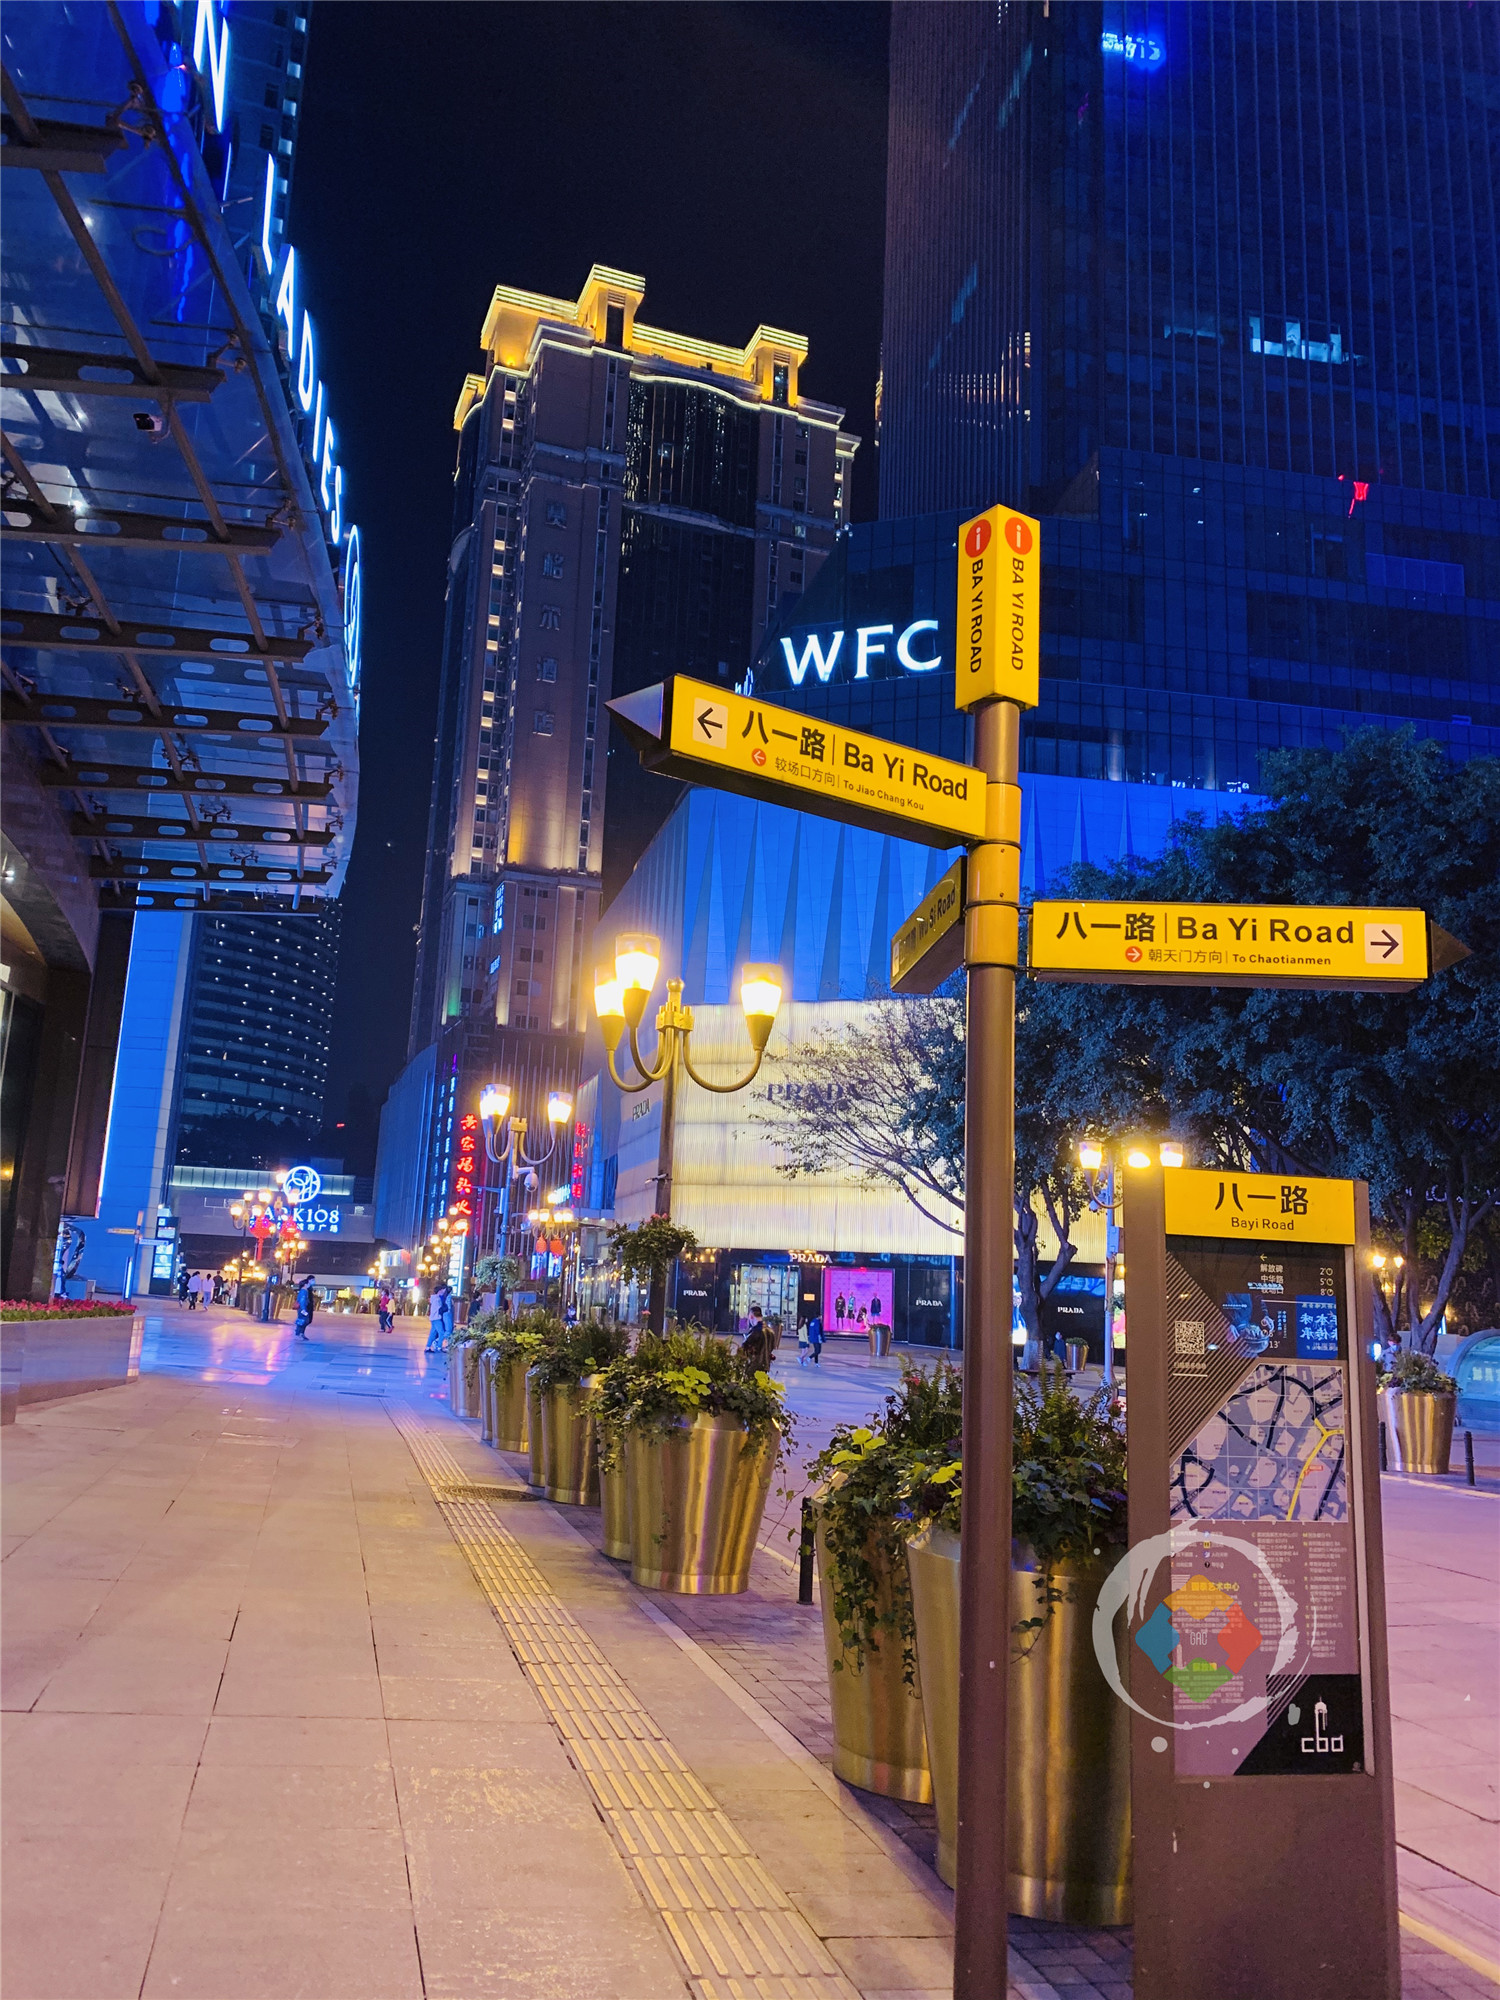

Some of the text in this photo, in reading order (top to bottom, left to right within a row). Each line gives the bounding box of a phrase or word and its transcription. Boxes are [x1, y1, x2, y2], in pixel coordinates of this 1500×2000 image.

[970, 559, 984, 674] BA YI ROAD
[1011, 557, 1025, 671] BA YI ROAD
[780, 620, 942, 685] WFC
[742, 710, 969, 802] 八一路 Ba Yi Road
[774, 756, 925, 811] 较场口方向 To Jiao Chang Kou
[937, 884, 956, 920] Road
[1056, 911, 1355, 945] 八一路 Ba Yi Road
[1147, 948, 1332, 967] 朝天门方向 To Chaotianmen
[632, 1098, 651, 1122] PRADA
[1215, 1182, 1309, 1216] 八一路
[1231, 1217, 1295, 1231] Bayi Road
[789, 1253, 833, 1264] PRADA
[683, 1289, 708, 1297] PRADA
[915, 1298, 943, 1307] PRADA
[1057, 1306, 1084, 1314] PRADA
